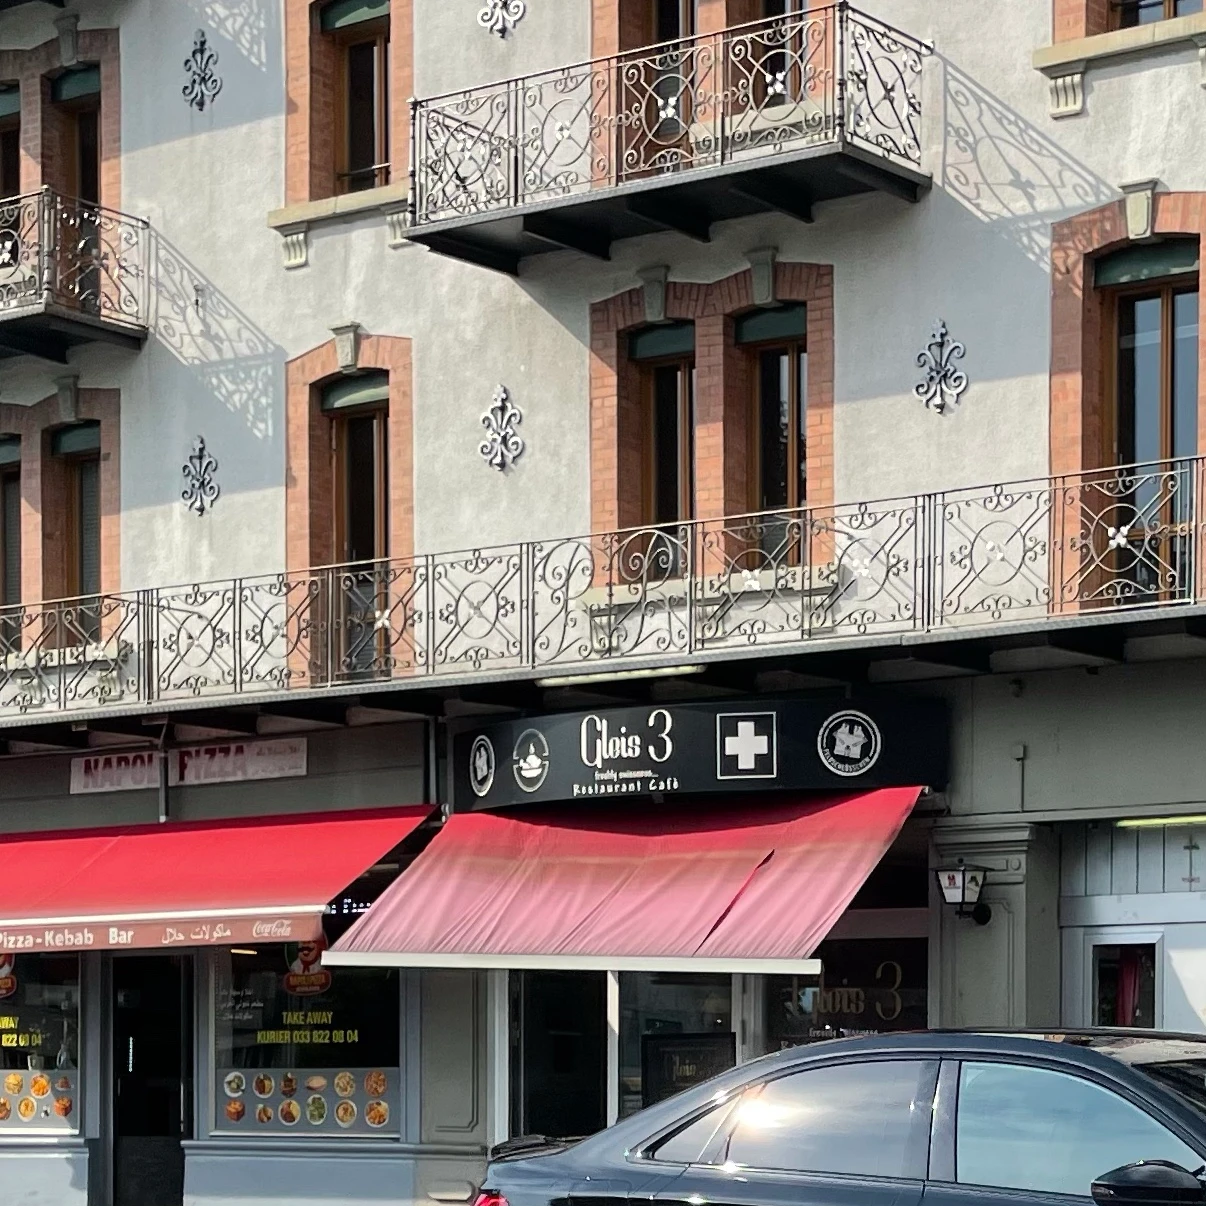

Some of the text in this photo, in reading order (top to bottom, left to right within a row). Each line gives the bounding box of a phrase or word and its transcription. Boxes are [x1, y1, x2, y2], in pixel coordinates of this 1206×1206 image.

[648, 709, 673, 762] 3
[83, 752, 158, 789] NAPOL
[178, 745, 247, 782] PIZZA
[573, 780, 641, 797] Restaurant
[108, 927, 134, 944] Bar
[252, 919, 292, 938] Coca-Cola
[875, 960, 902, 1021] 3
[282, 1011, 333, 1025] TAKE AWAY
[292, 1030, 310, 1043] 033
[312, 1030, 330, 1043] 822
[346, 1029, 359, 1043] 04
